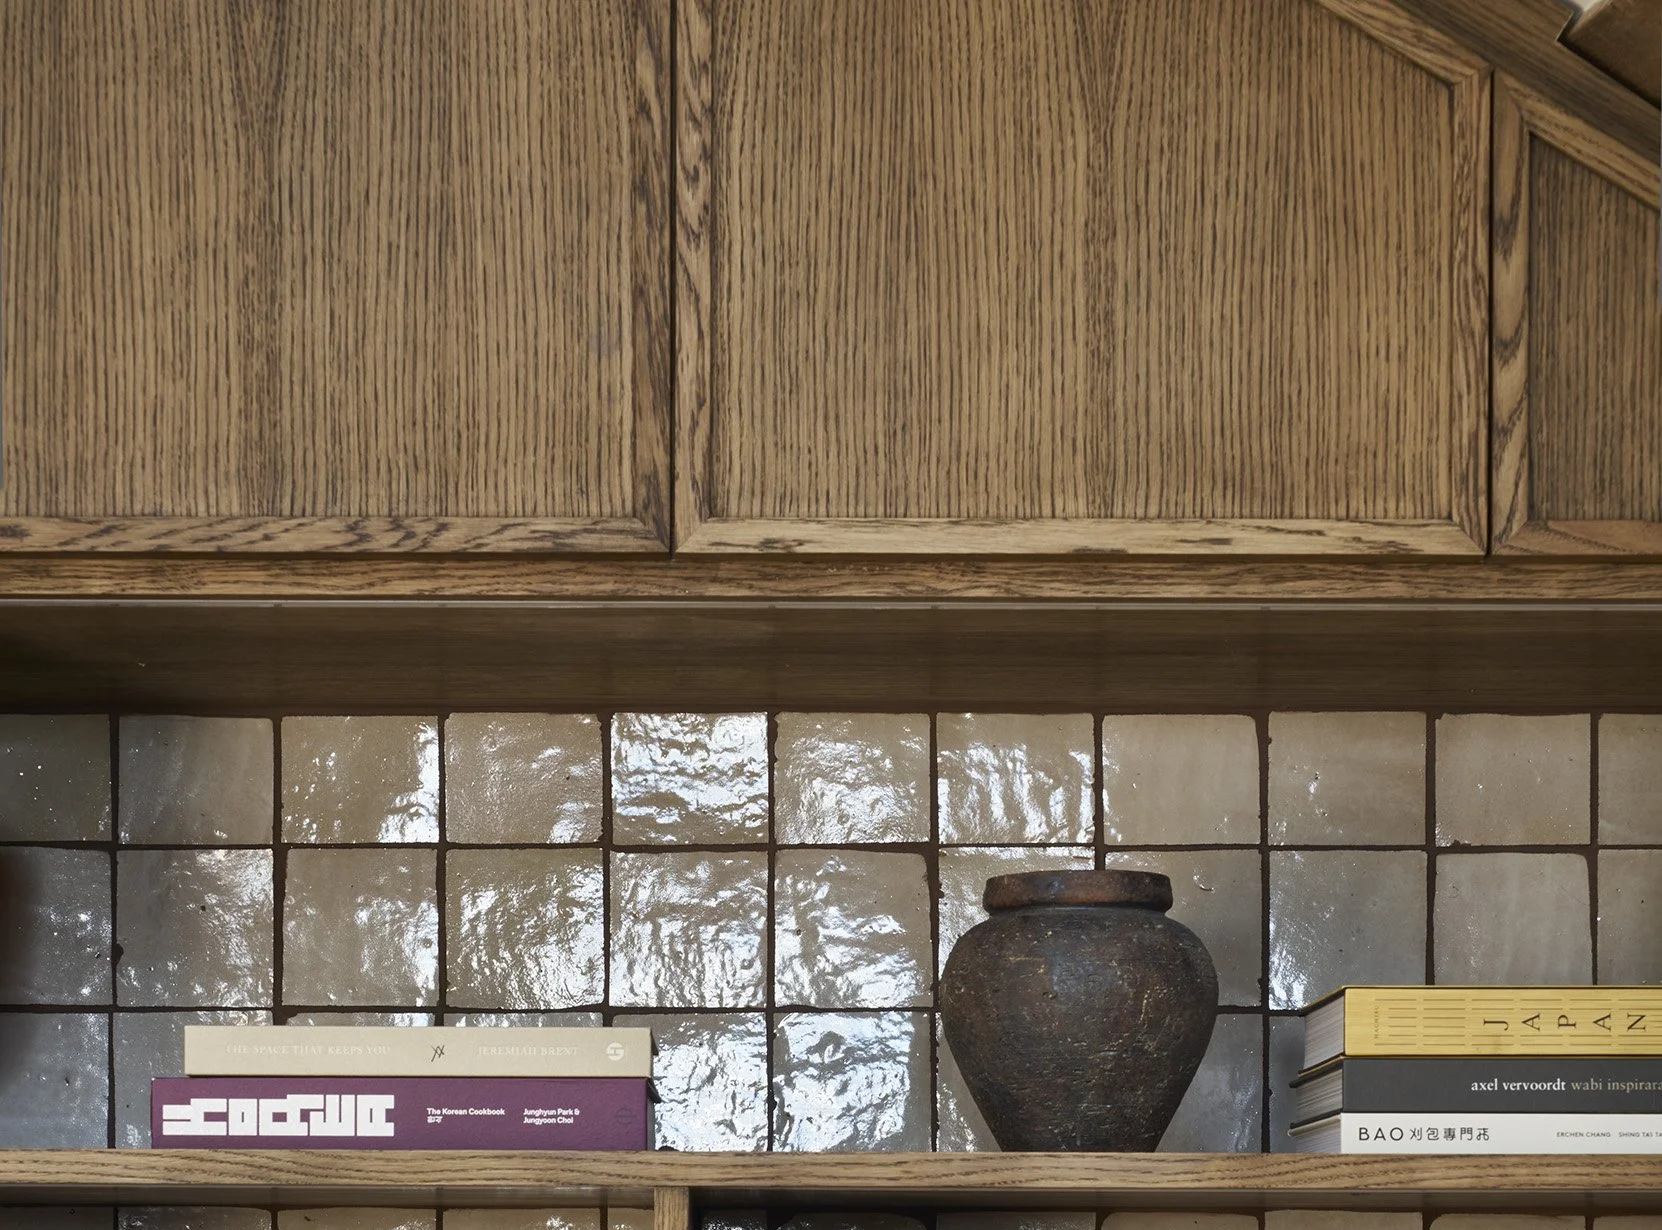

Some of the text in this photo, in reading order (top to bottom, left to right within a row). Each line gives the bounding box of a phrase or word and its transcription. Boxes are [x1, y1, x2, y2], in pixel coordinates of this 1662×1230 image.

[1483, 1012, 1647, 1033] JAPAN
[226, 1044, 391, 1055] THE SPACE THAT KEEPS YOU
[477, 1046, 579, 1056] JEREMIAH BRENT
[1471, 1078, 1498, 1091] axel
[1502, 1078, 1566, 1091] vervoordt
[1571, 1078, 1604, 1091] wabi
[426, 1108, 505, 1116] The Korean Cookbook
[523, 1108, 580, 1117] Junghyun Park &
[523, 1117, 557, 1125] Jungyoon
[1358, 1127, 1404, 1141] BAO
